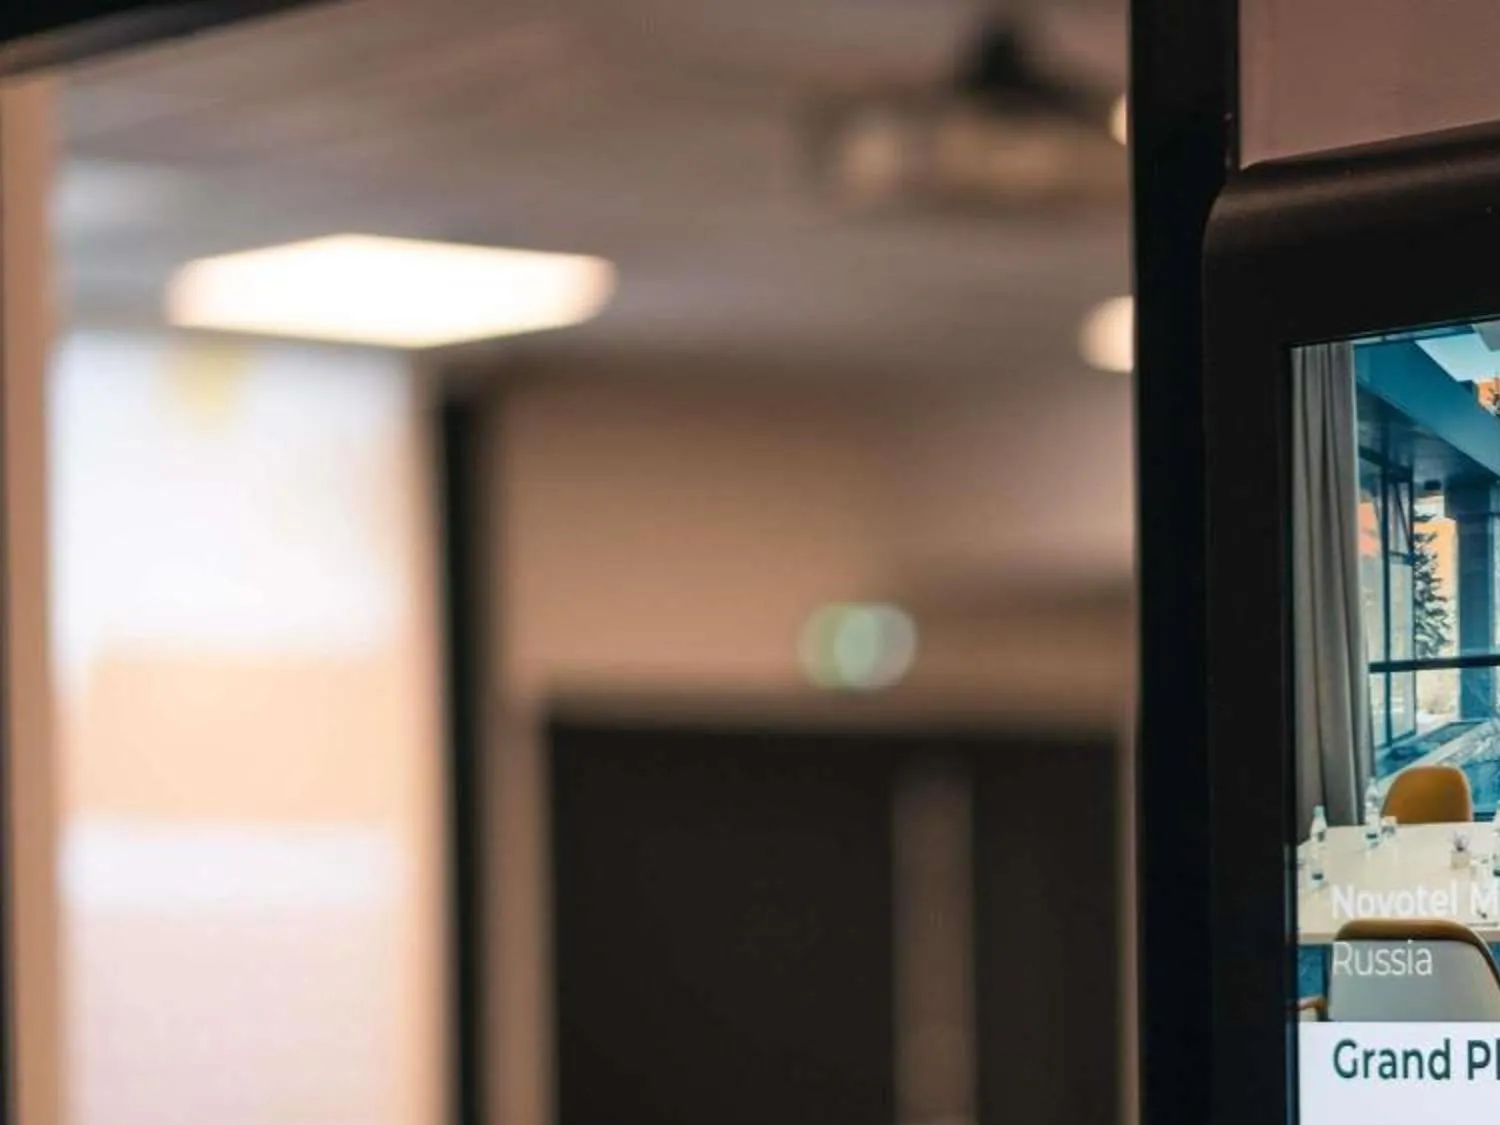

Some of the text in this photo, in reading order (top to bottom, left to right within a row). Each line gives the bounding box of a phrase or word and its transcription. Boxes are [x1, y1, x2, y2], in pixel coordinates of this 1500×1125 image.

[1331, 882, 1458, 919] Novotel
[1332, 939, 1434, 977] Russia
[1332, 1038, 1451, 1080] Grand
